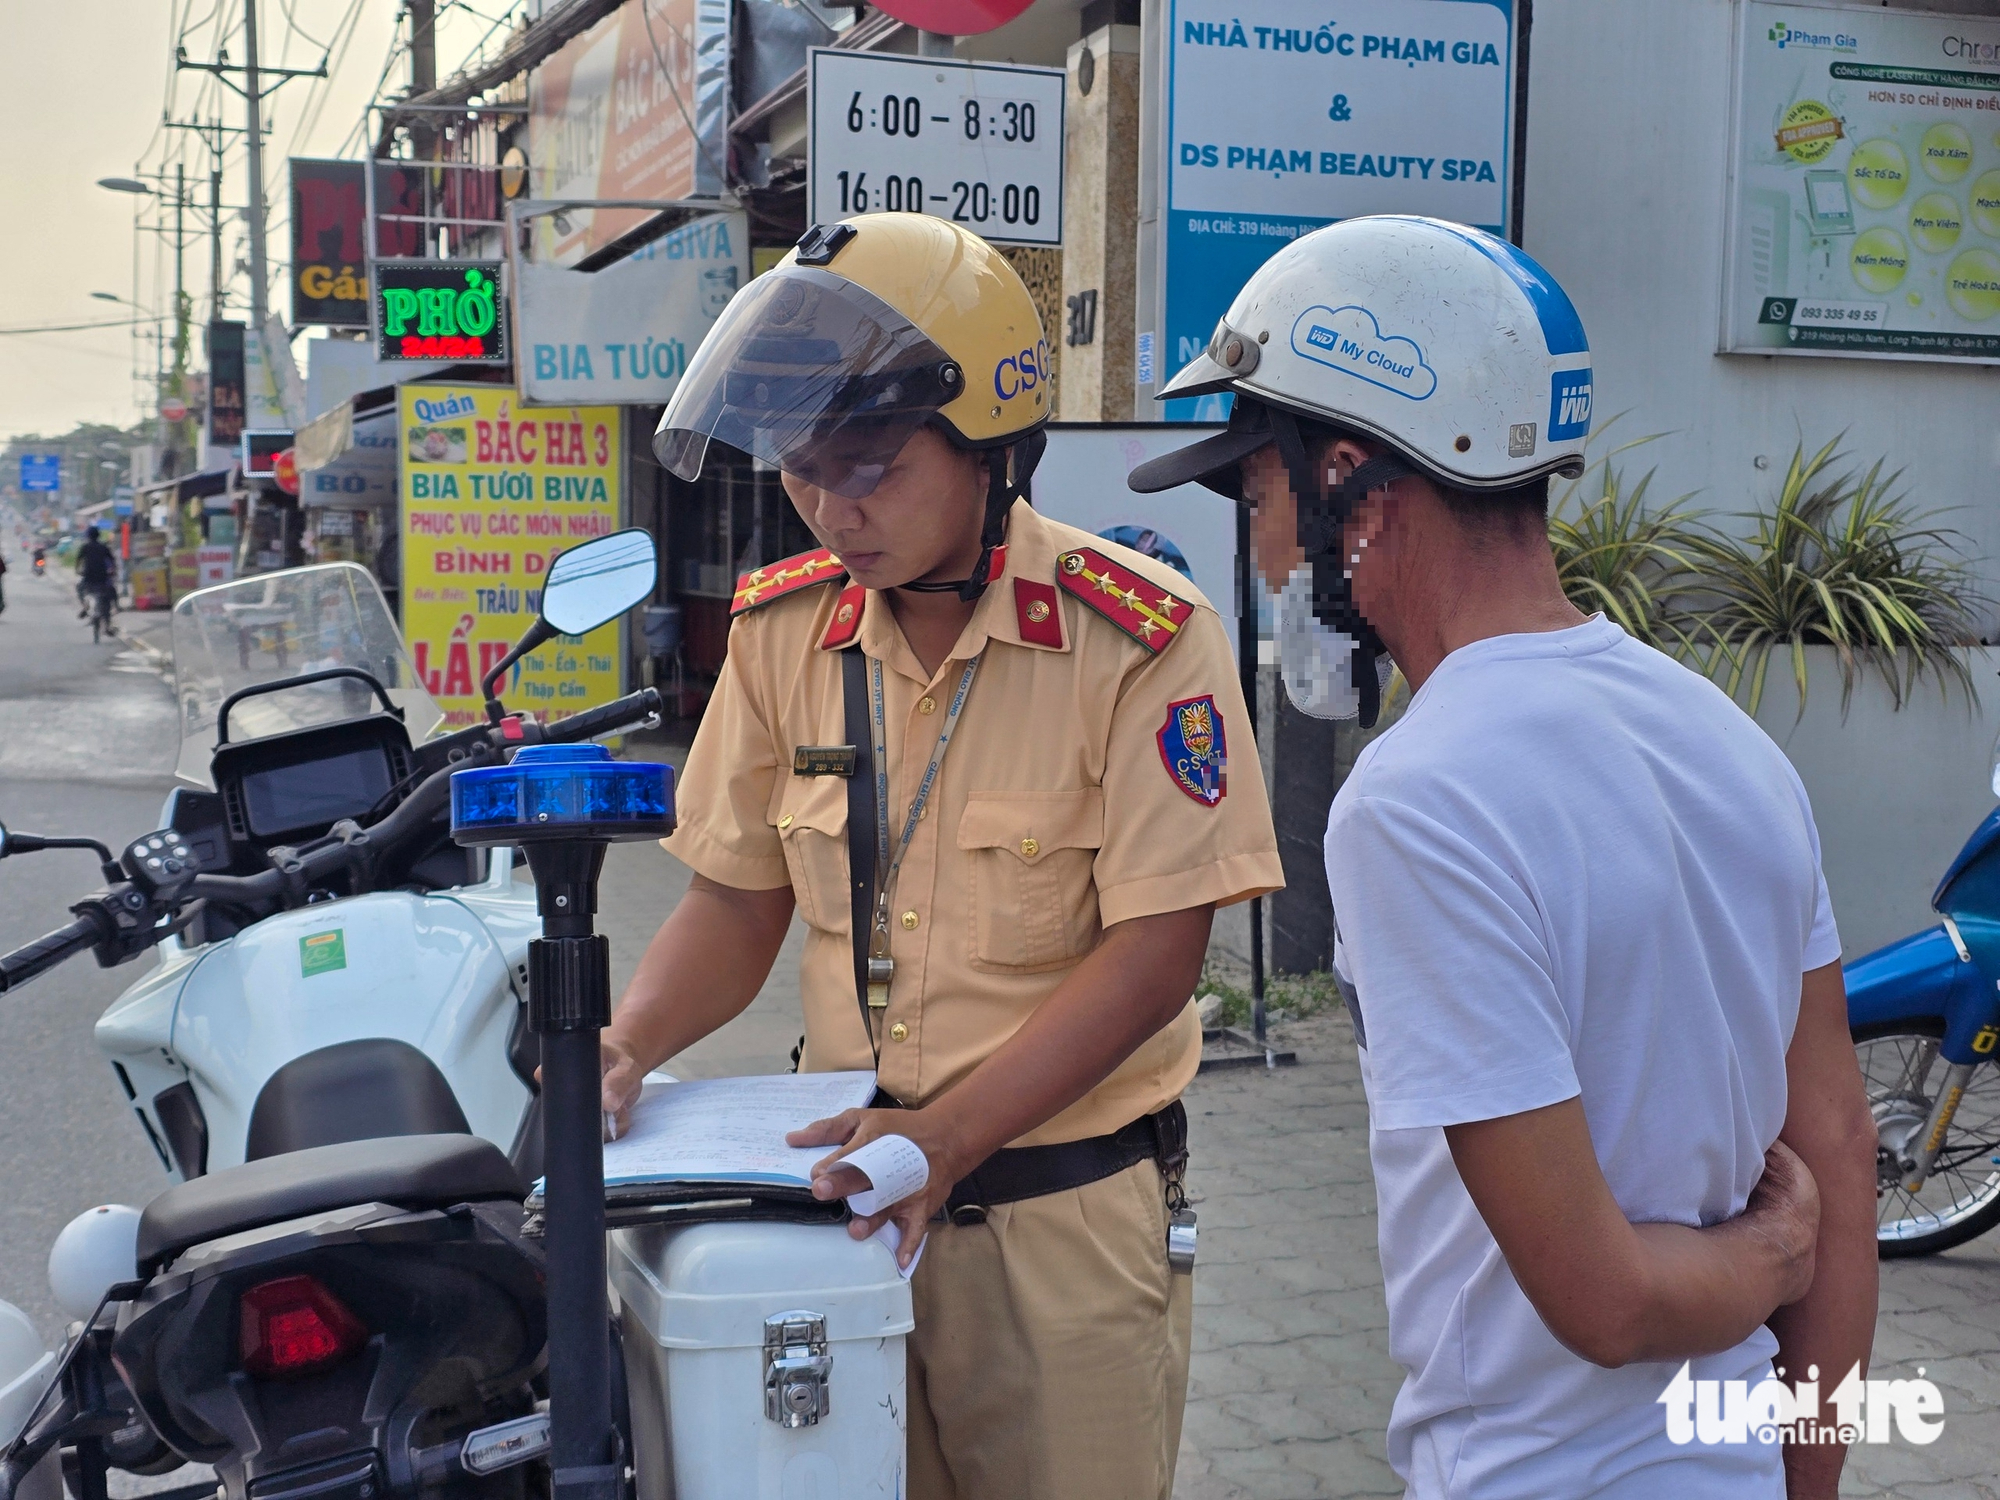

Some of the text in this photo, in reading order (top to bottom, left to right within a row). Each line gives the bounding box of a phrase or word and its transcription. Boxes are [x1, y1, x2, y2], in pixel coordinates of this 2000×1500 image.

[1183, 18, 1499, 68] NHÀ THUỐC PHẠM GIA
[1793, 30, 1857, 48] Phạm Gia
[1834, 65, 1860, 76] CÔNG
[1328, 94, 1352, 122] &
[1868, 91, 1896, 103] HƠN
[1900, 93, 1915, 104] 50
[1918, 91, 1940, 106] CHỈ
[1943, 96, 1973, 111] ĐỊNH
[847, 91, 920, 138] 6:00
[964, 100, 1035, 142] 8:30
[1180, 143, 1496, 183] DS PHẠM BEAUTY SPA
[1888, 170, 1902, 180] Da
[1188, 219, 1210, 234] ĐỊA
[1239, 221, 1258, 236] 319
[1260, 223, 1297, 240] Hoàng
[382, 268, 495, 336] PHỞ
[1801, 307, 1878, 321] 093 335 49 55
[400, 336, 484, 358] 24/24
[1801, 331, 1817, 341] 319
[1819, 331, 1845, 343] Hoàng
[1888, 335, 1909, 347] Long
[534, 335, 686, 380] BIA TƯƠI
[1310, 328, 1414, 379] WD My Cloud
[414, 394, 476, 422] Quán
[1557, 384, 1592, 426] WD
[475, 399, 609, 467] BẮC HÀ 3
[412, 470, 609, 502] BIA TƯƠI BIVA
[410, 512, 455, 539] PHỤC
[460, 513, 481, 539] VỤ
[487, 508, 520, 535] CÁC
[526, 510, 562, 536] MÓN
[434, 546, 511, 574] BÌNH
[475, 582, 520, 614] TRÂU
[414, 614, 510, 696] LẨU
[524, 654, 545, 671] Thỏ
[556, 649, 577, 672] Ếch
[587, 655, 611, 672] Thái
[524, 679, 586, 699] Thập Cẩm
[961, 671, 972, 690] GIAO
[874, 703, 882, 726] CẢNH
[949, 690, 964, 717] THÔNG
[878, 773, 886, 799] THÔNG
[902, 761, 937, 844] CẢNH SÁT GIAO THÔNG
